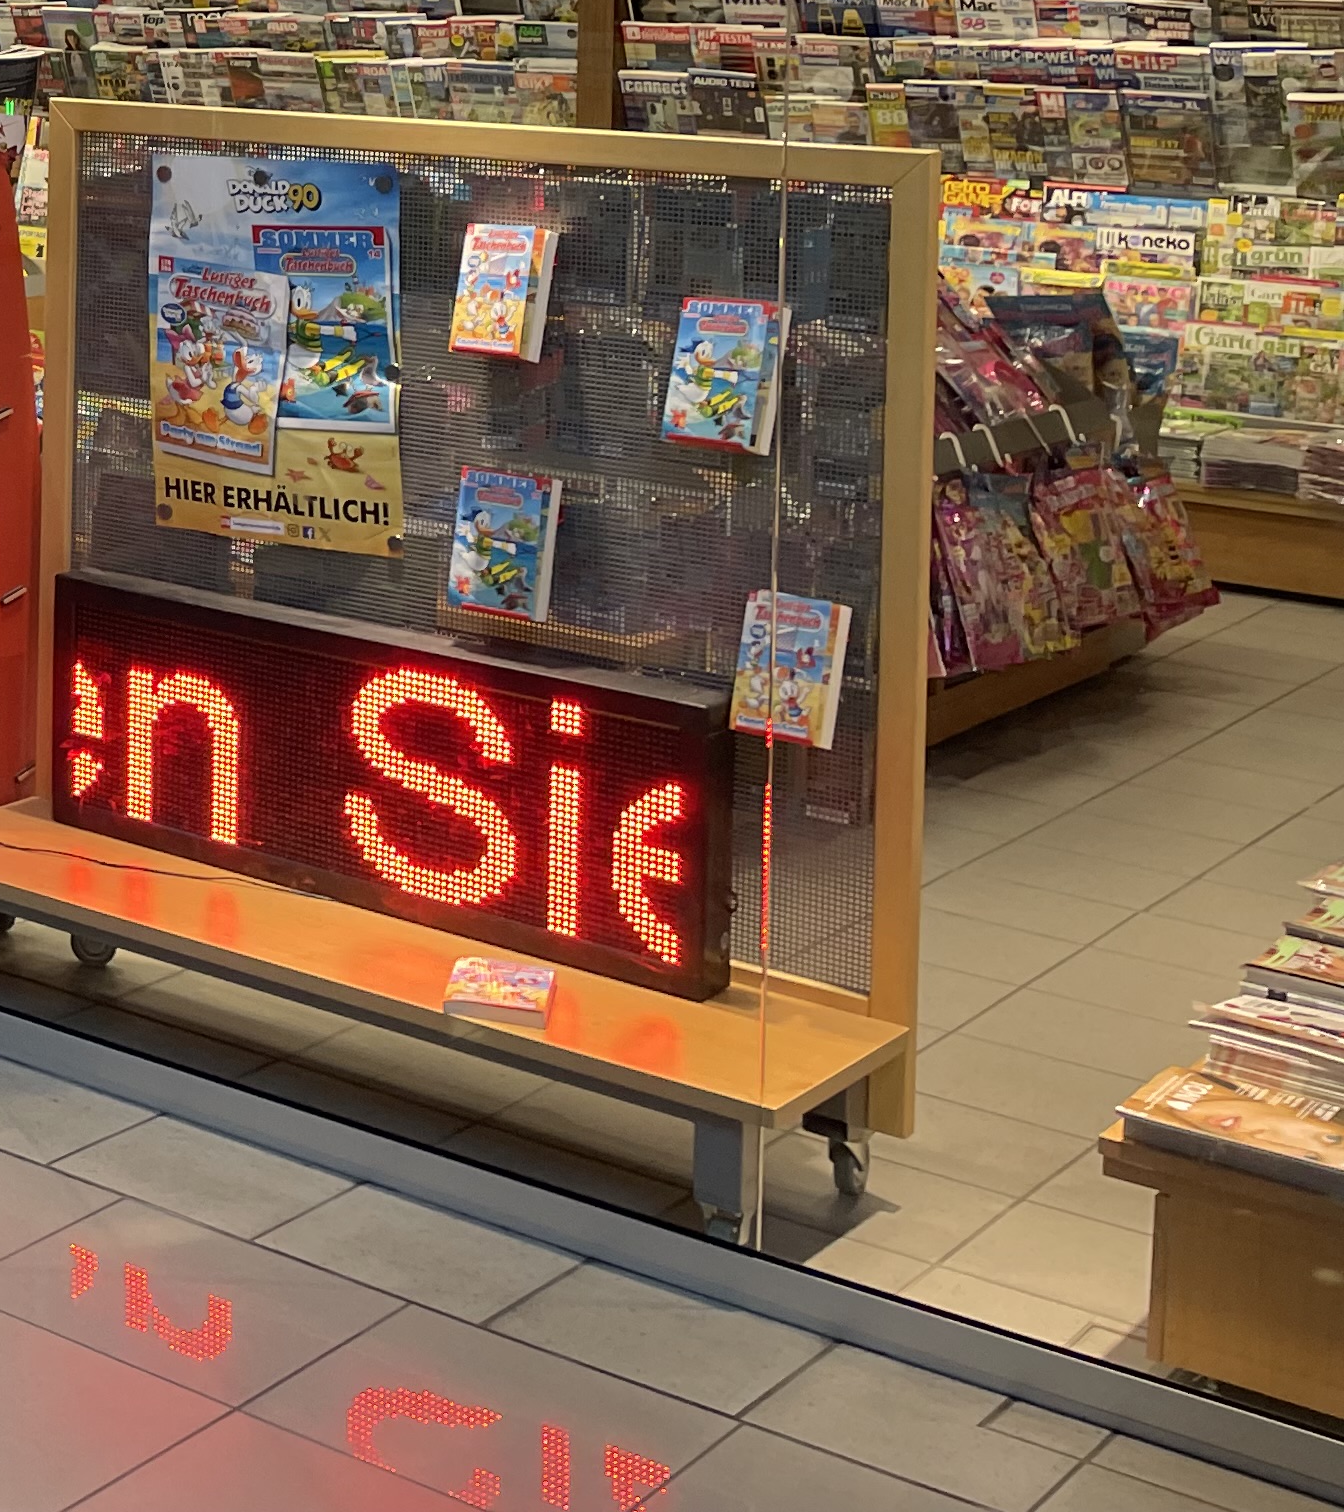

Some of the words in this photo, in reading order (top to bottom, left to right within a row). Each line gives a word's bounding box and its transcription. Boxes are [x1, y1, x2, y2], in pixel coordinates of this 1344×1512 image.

[960, 0, 998, 13] Mac
[1115, 54, 1177, 70] CHIP
[694, 76, 728, 87] AUDIO
[729, 78, 755, 88] TEST
[226, 179, 290, 196] DONALD
[944, 182, 990, 195] retro
[234, 194, 290, 213] DUCK
[288, 183, 322, 212] 90
[262, 229, 374, 248] SOMMER
[1118, 231, 1191, 251] koneko
[285, 258, 354, 272] Taschenbuch
[202, 267, 257, 289] Lustiges
[171, 277, 272, 314] Taschenbuch
[161, 422, 195, 442] Party
[218, 436, 262, 455] Strand
[164, 476, 216, 505] HIER
[223, 484, 390, 526] ERHÄLTLICH!
